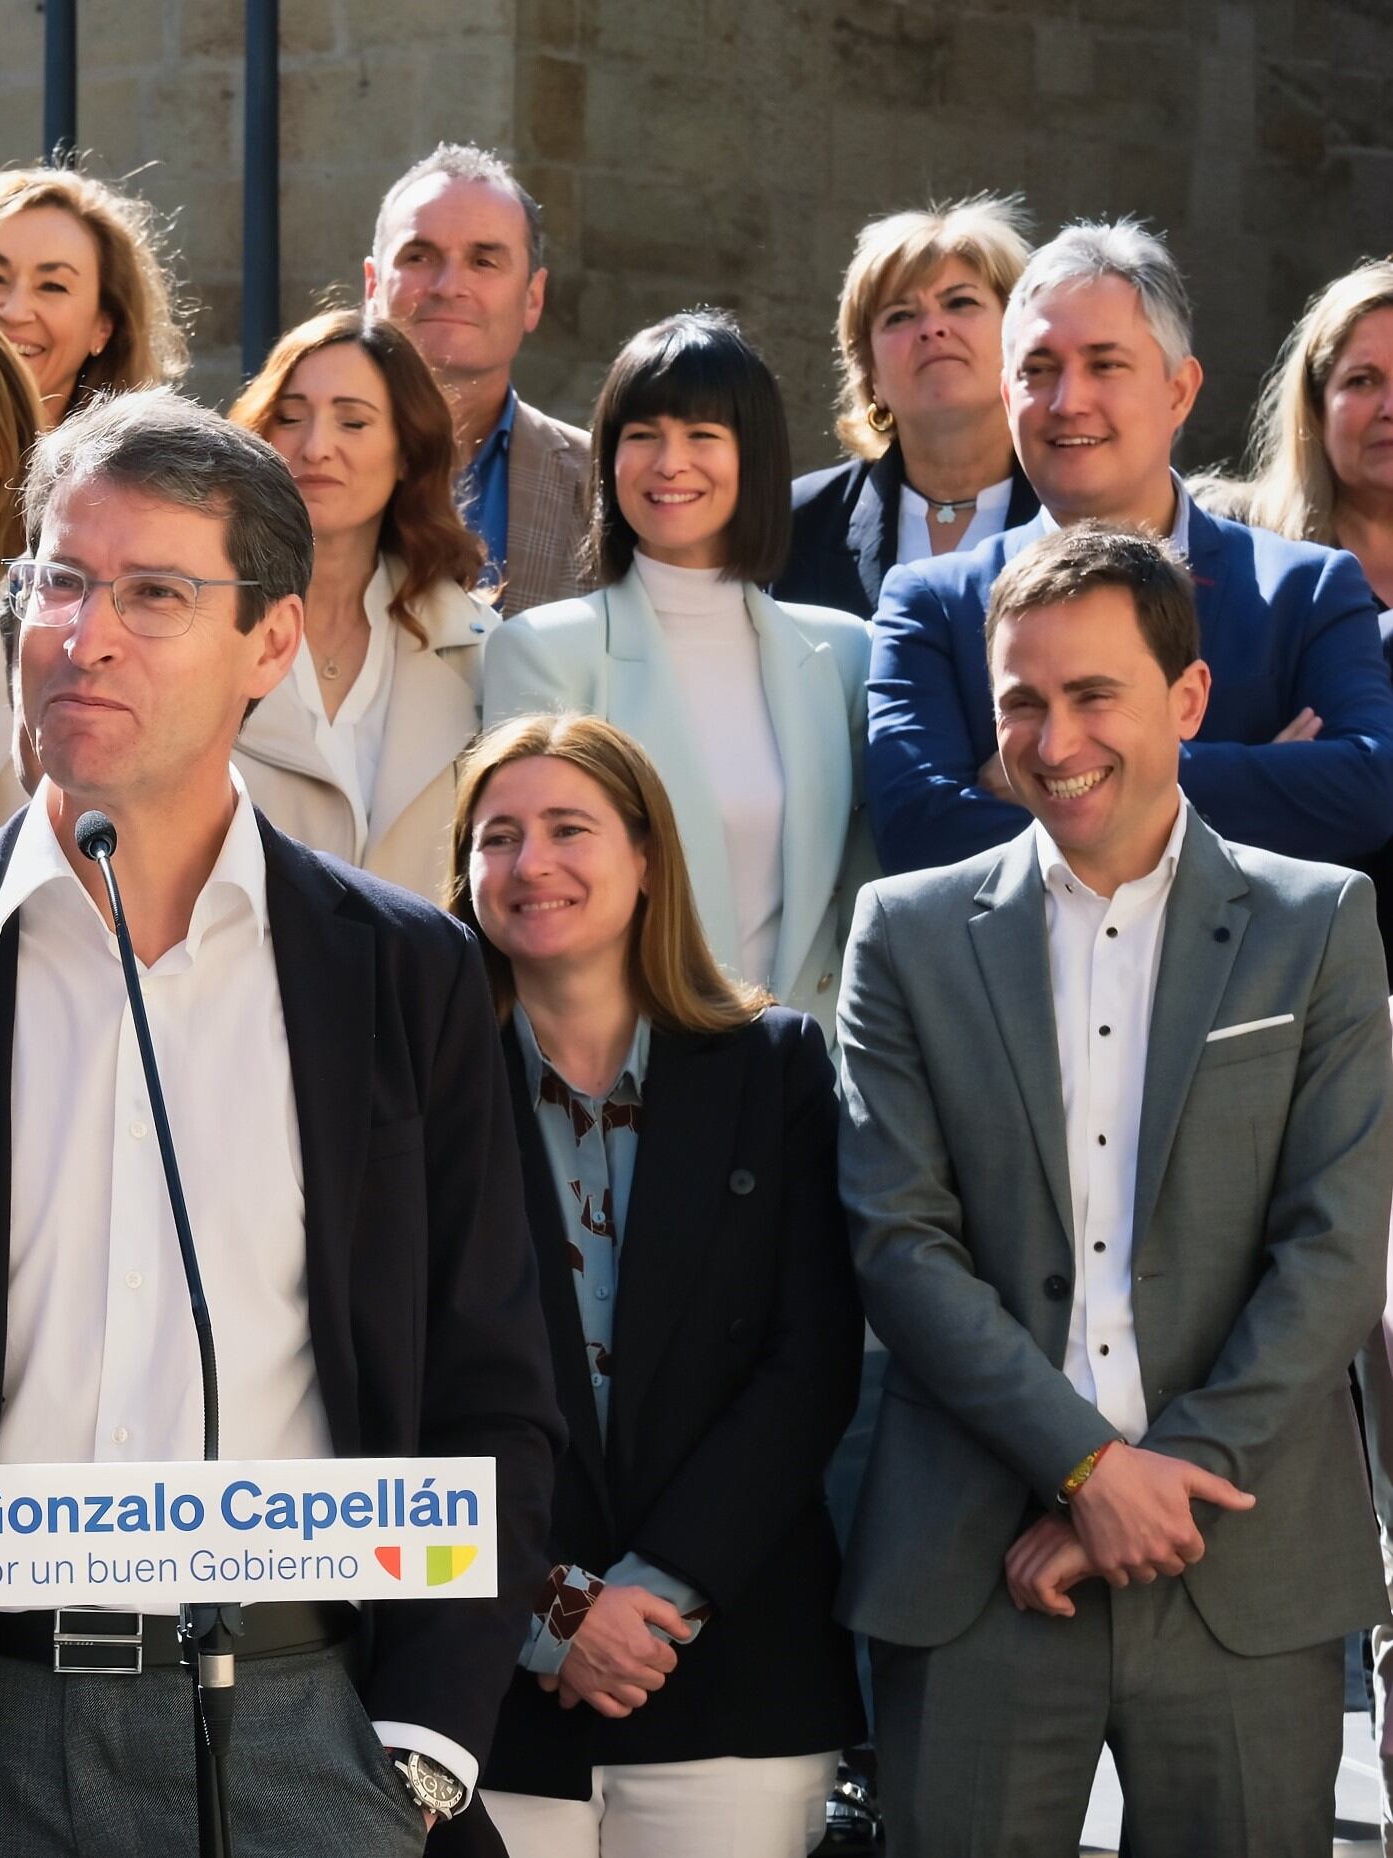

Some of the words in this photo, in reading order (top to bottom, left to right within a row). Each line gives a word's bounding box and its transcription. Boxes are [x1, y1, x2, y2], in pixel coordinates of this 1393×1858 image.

[220, 1477, 479, 1541] Capellán
[31, 1560, 74, 1586] un
[88, 1551, 178, 1584] buen
[189, 1548, 360, 1582] Gobierno
